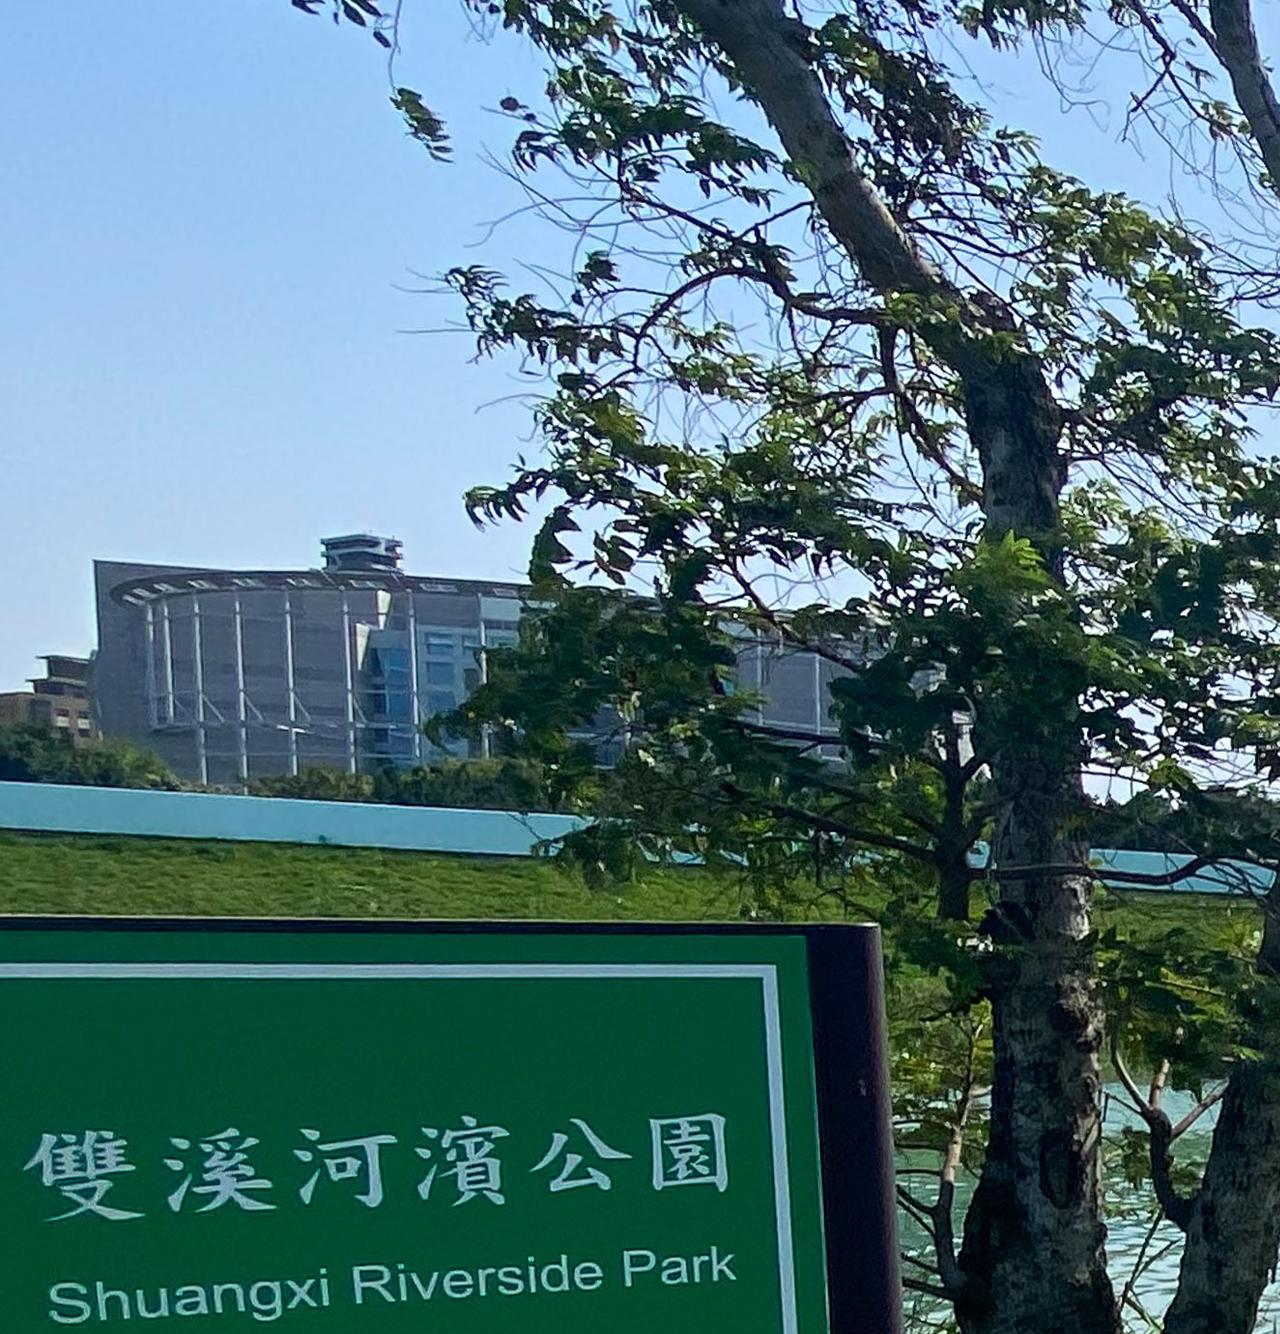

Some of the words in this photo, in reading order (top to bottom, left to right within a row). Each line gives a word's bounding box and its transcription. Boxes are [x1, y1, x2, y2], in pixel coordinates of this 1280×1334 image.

[24, 1114, 728, 1220] 雙溪河濱公園
[50, 1267, 330, 1324] Shuangxi
[354, 1255, 603, 1304] Riverside
[624, 1246, 737, 1287] Park
